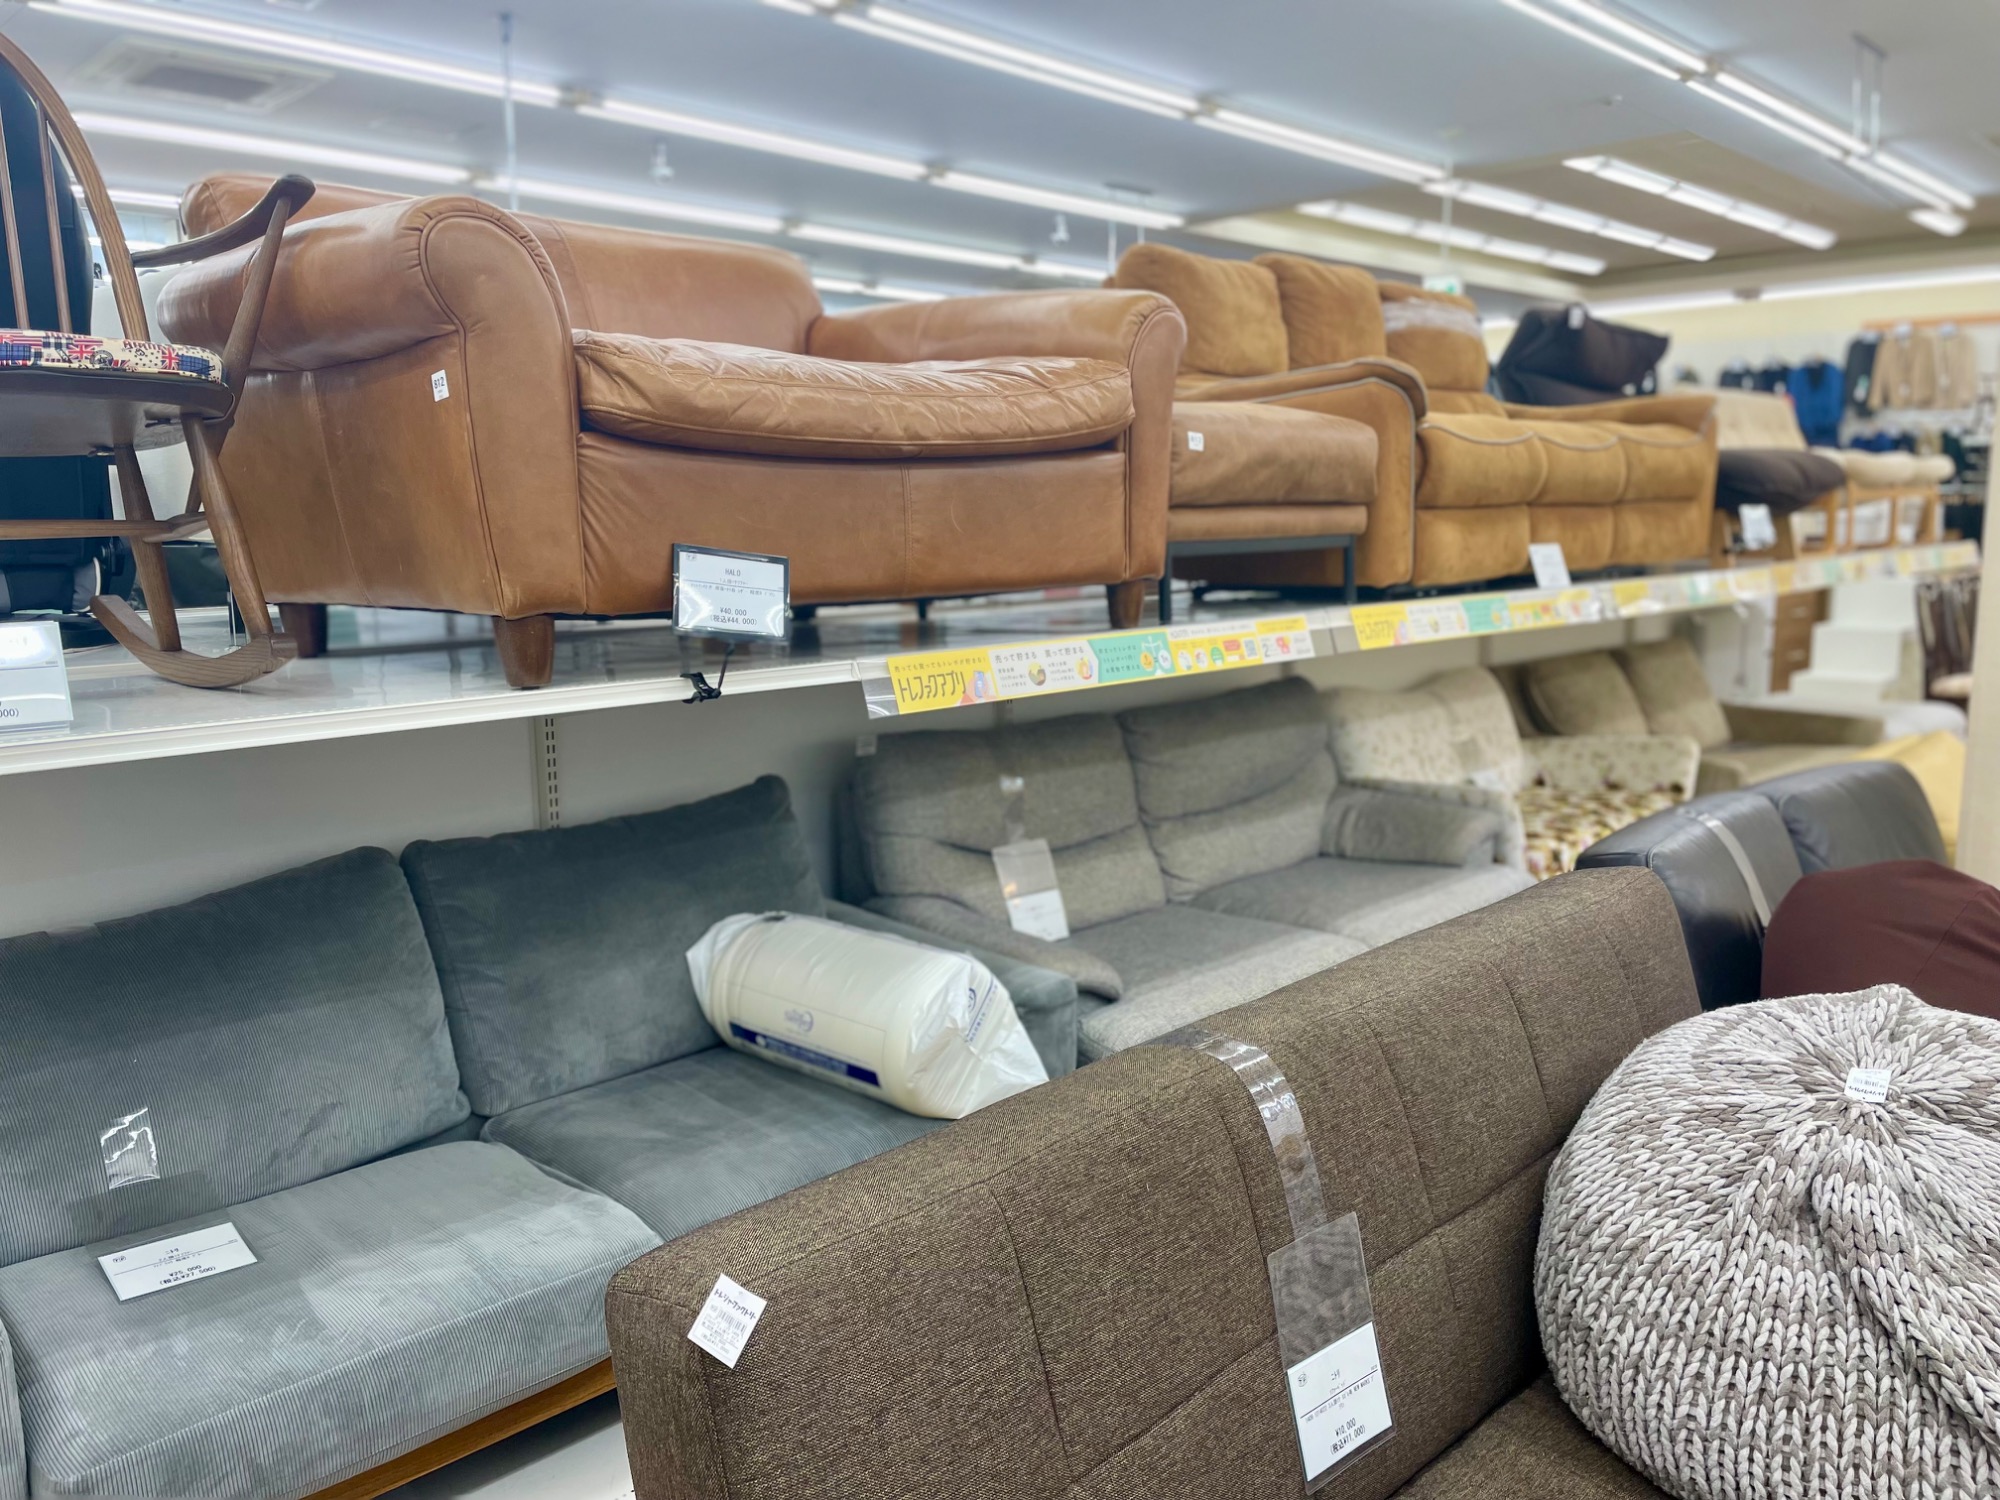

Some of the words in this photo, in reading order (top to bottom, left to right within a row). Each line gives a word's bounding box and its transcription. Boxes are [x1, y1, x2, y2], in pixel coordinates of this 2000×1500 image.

[897, 670, 966, 702] トレファクアプリ
